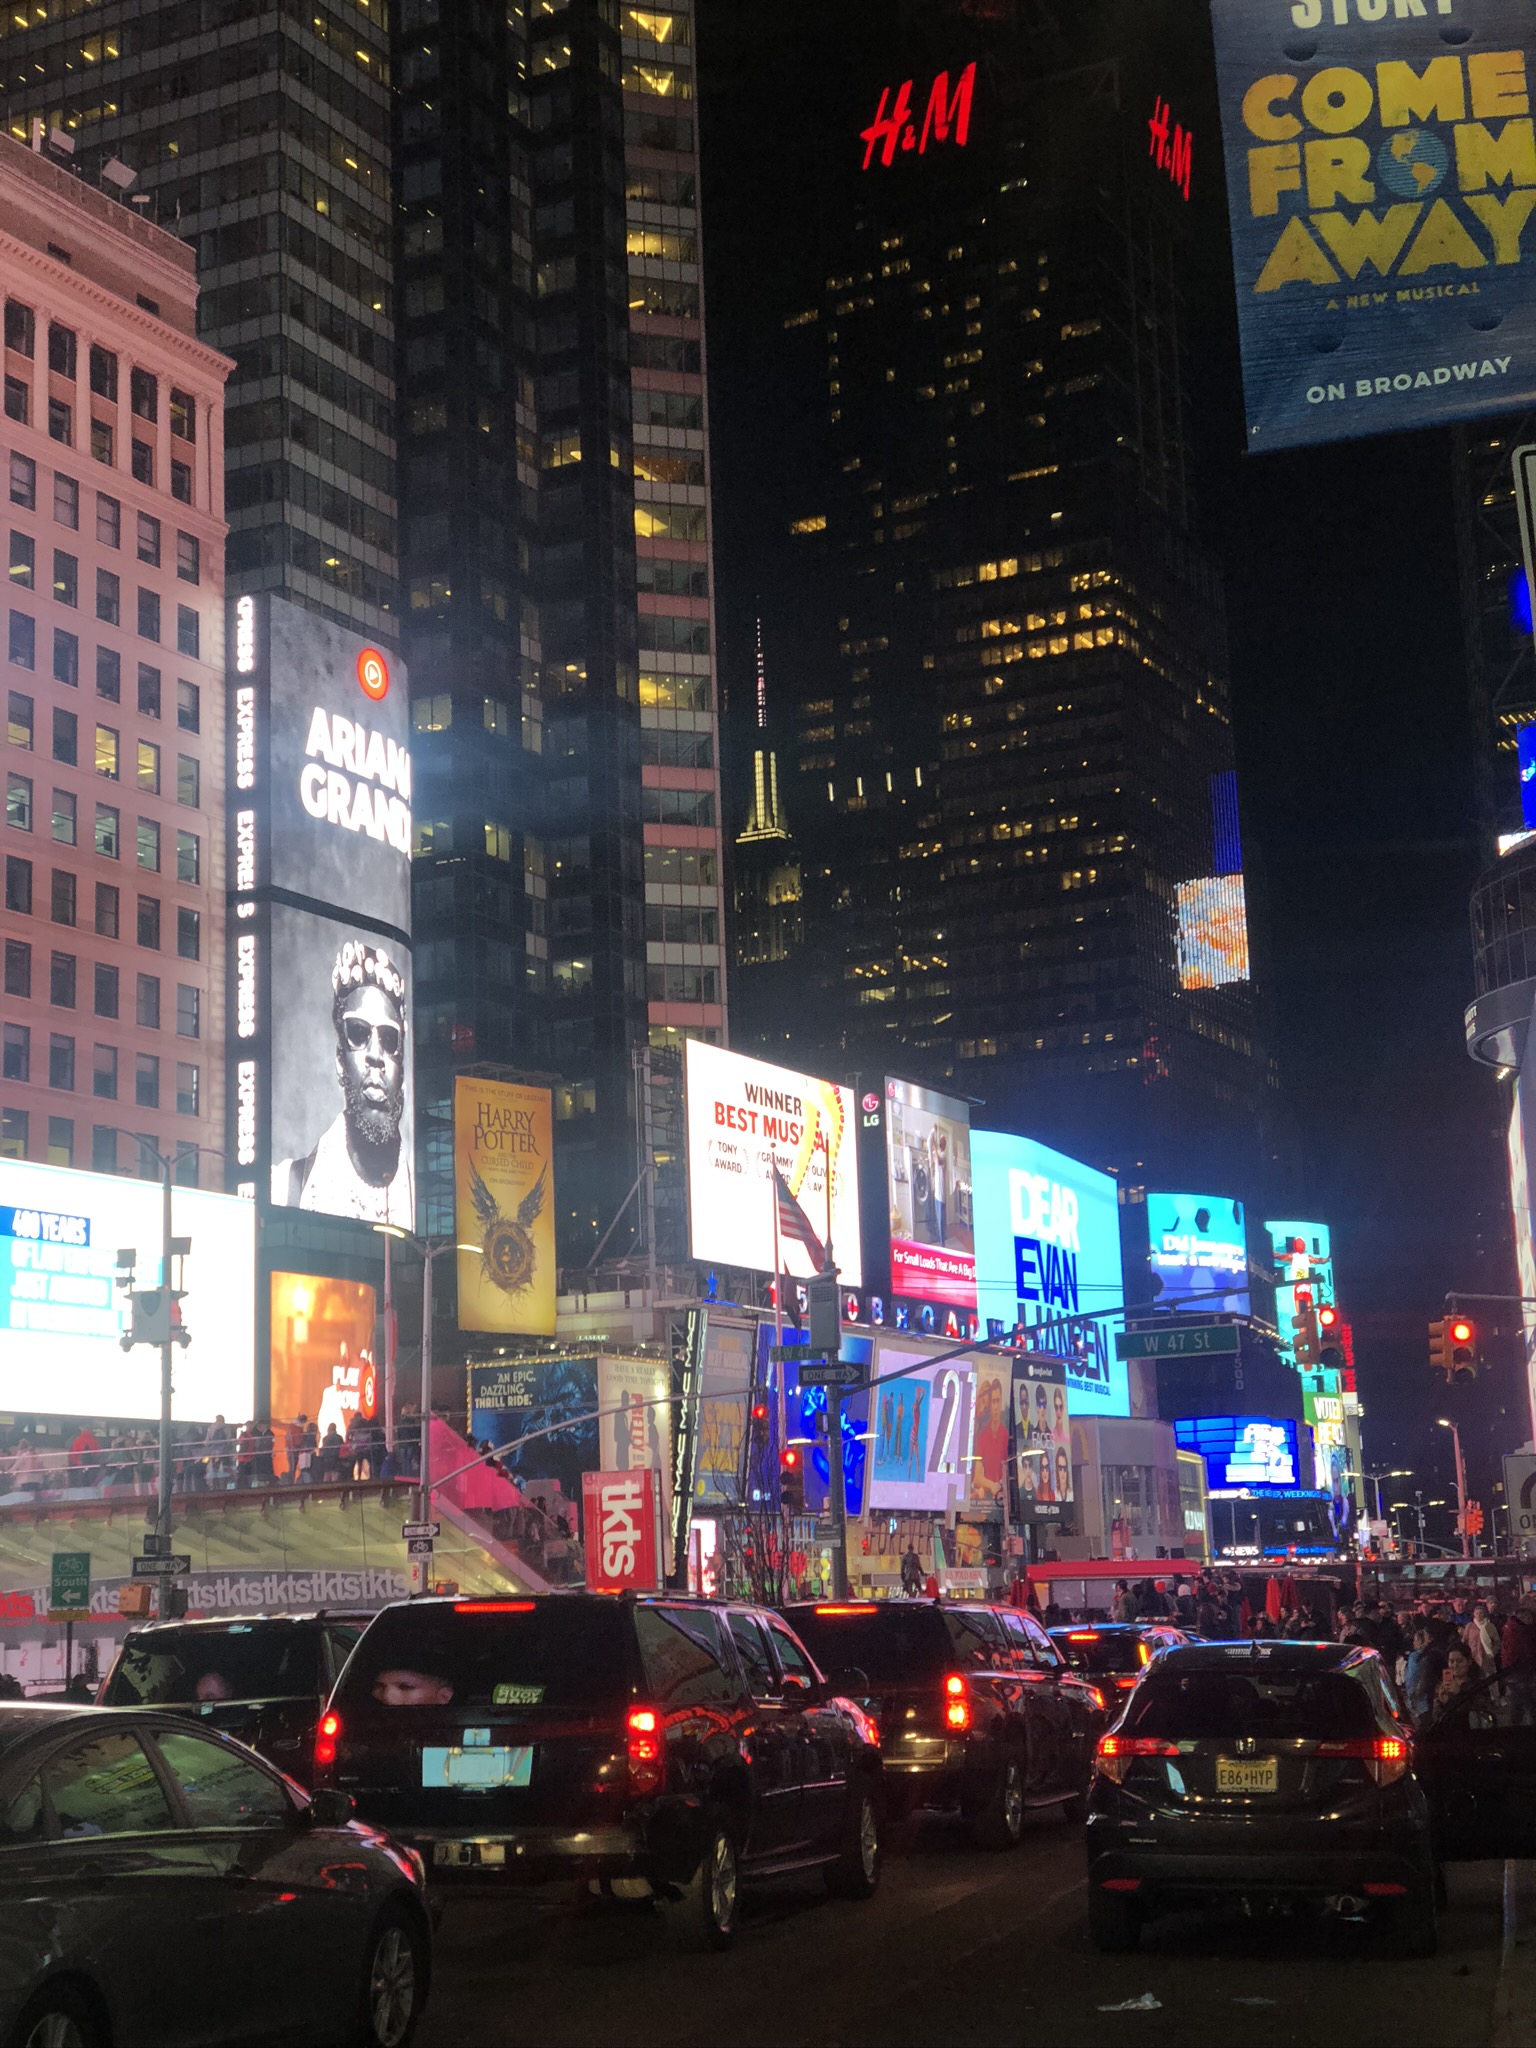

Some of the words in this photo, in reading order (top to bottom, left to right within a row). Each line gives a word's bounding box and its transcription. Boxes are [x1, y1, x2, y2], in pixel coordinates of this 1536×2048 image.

[1242, 50, 1530, 141] COME
[859, 61, 976, 171] H&M
[1148, 95, 1193, 202] H&M
[1253, 189, 1536, 293] AWAY
[1347, 291, 1388, 310] NEW
[1396, 281, 1480, 303] MUSICAL
[1306, 382, 1346, 403] ON
[1355, 355, 1512, 399] BROADWAY
[236, 686, 254, 790] EXPRESS
[237, 934, 255, 1038] EXPRESS
[237, 1060, 255, 1166] EXPRESS
[744, 1081, 803, 1117] WINNER
[477, 1101, 536, 1134] HARRY
[714, 1100, 759, 1134] BEST
[863, 1114, 880, 1128] LG
[472, 1124, 542, 1156] POTTER
[717, 1140, 738, 1156] TONY
[480, 1155, 510, 1167] CURSED
[510, 1158, 534, 1170] CHILD
[714, 1158, 742, 1174] AWARD
[1008, 1167, 1081, 1252] DEAR
[40, 1212, 87, 1246] YEARS
[893, 1248, 904, 1263] For
[904, 1251, 920, 1267] Small
[919, 1255, 936, 1270] Loads
[935, 1257, 948, 1273] That
[948, 1260, 958, 1275] Are
[963, 1263, 973, 1281] Big
[1013, 1235, 1079, 1313] EVAN
[1143, 1335, 1159, 1353] W
[1167, 1333, 1186, 1351] 47
[1193, 1331, 1211, 1349] St
[625, 1375, 640, 1384] TIME
[636, 1365, 656, 1376] REALLY
[807, 1371, 825, 1380] ONE
[834, 1369, 854, 1380] WAY
[474, 1395, 506, 1409] THRILL
[480, 1382, 525, 1397] DAZZLING
[937, 1369, 978, 1475] 21
[1031, 1431, 1056, 1450] FACES
[406, 1527, 417, 1535] ONE
[422, 1526, 435, 1535] WAY
[601, 1479, 643, 1578] tkts
[140, 1562, 157, 1570] ONE
[165, 1561, 181, 1570] WAY
[54, 1577, 88, 1588] South
[0, 1591, 34, 1618] kts
